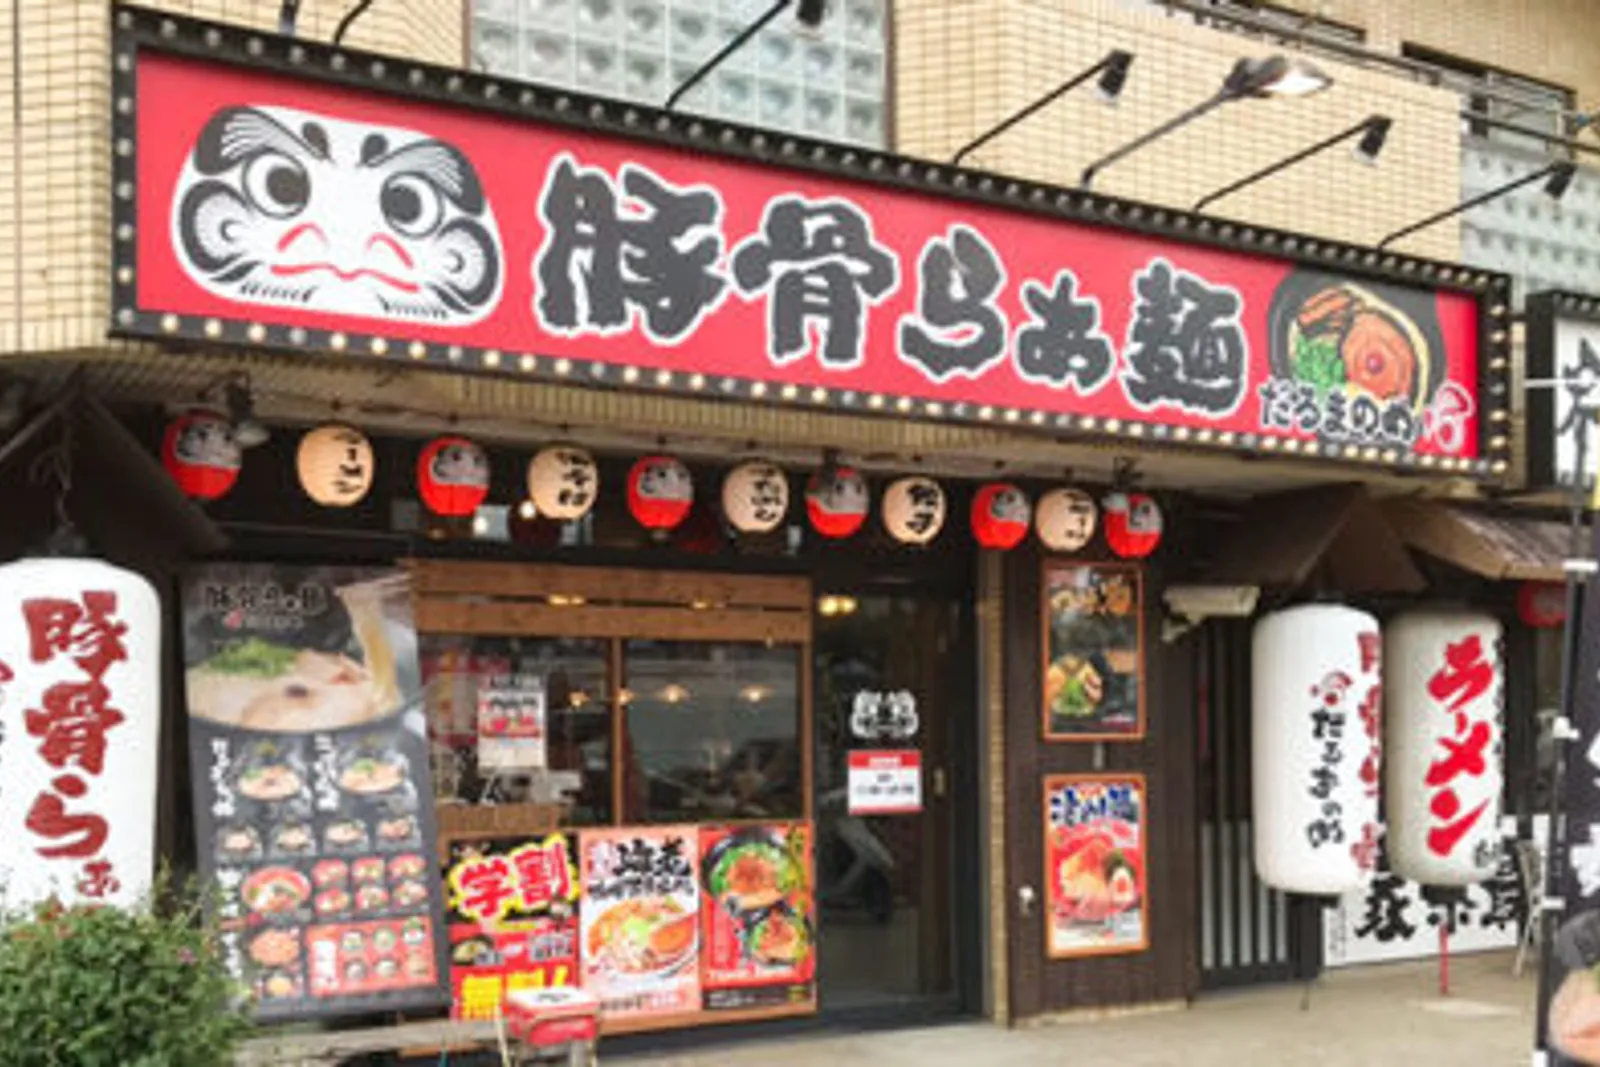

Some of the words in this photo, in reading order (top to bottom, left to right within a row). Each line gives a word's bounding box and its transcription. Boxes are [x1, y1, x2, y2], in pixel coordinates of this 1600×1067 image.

[533, 152, 1247, 417] 豚骨らぁ麺
[1259, 371, 1418, 446] だるまのめ
[22, 590, 129, 905] 豚骨らぁ
[1306, 707, 1346, 849] だるまのめ
[1424, 633, 1494, 857] ラーメン
[458, 842, 571, 919] 学割
